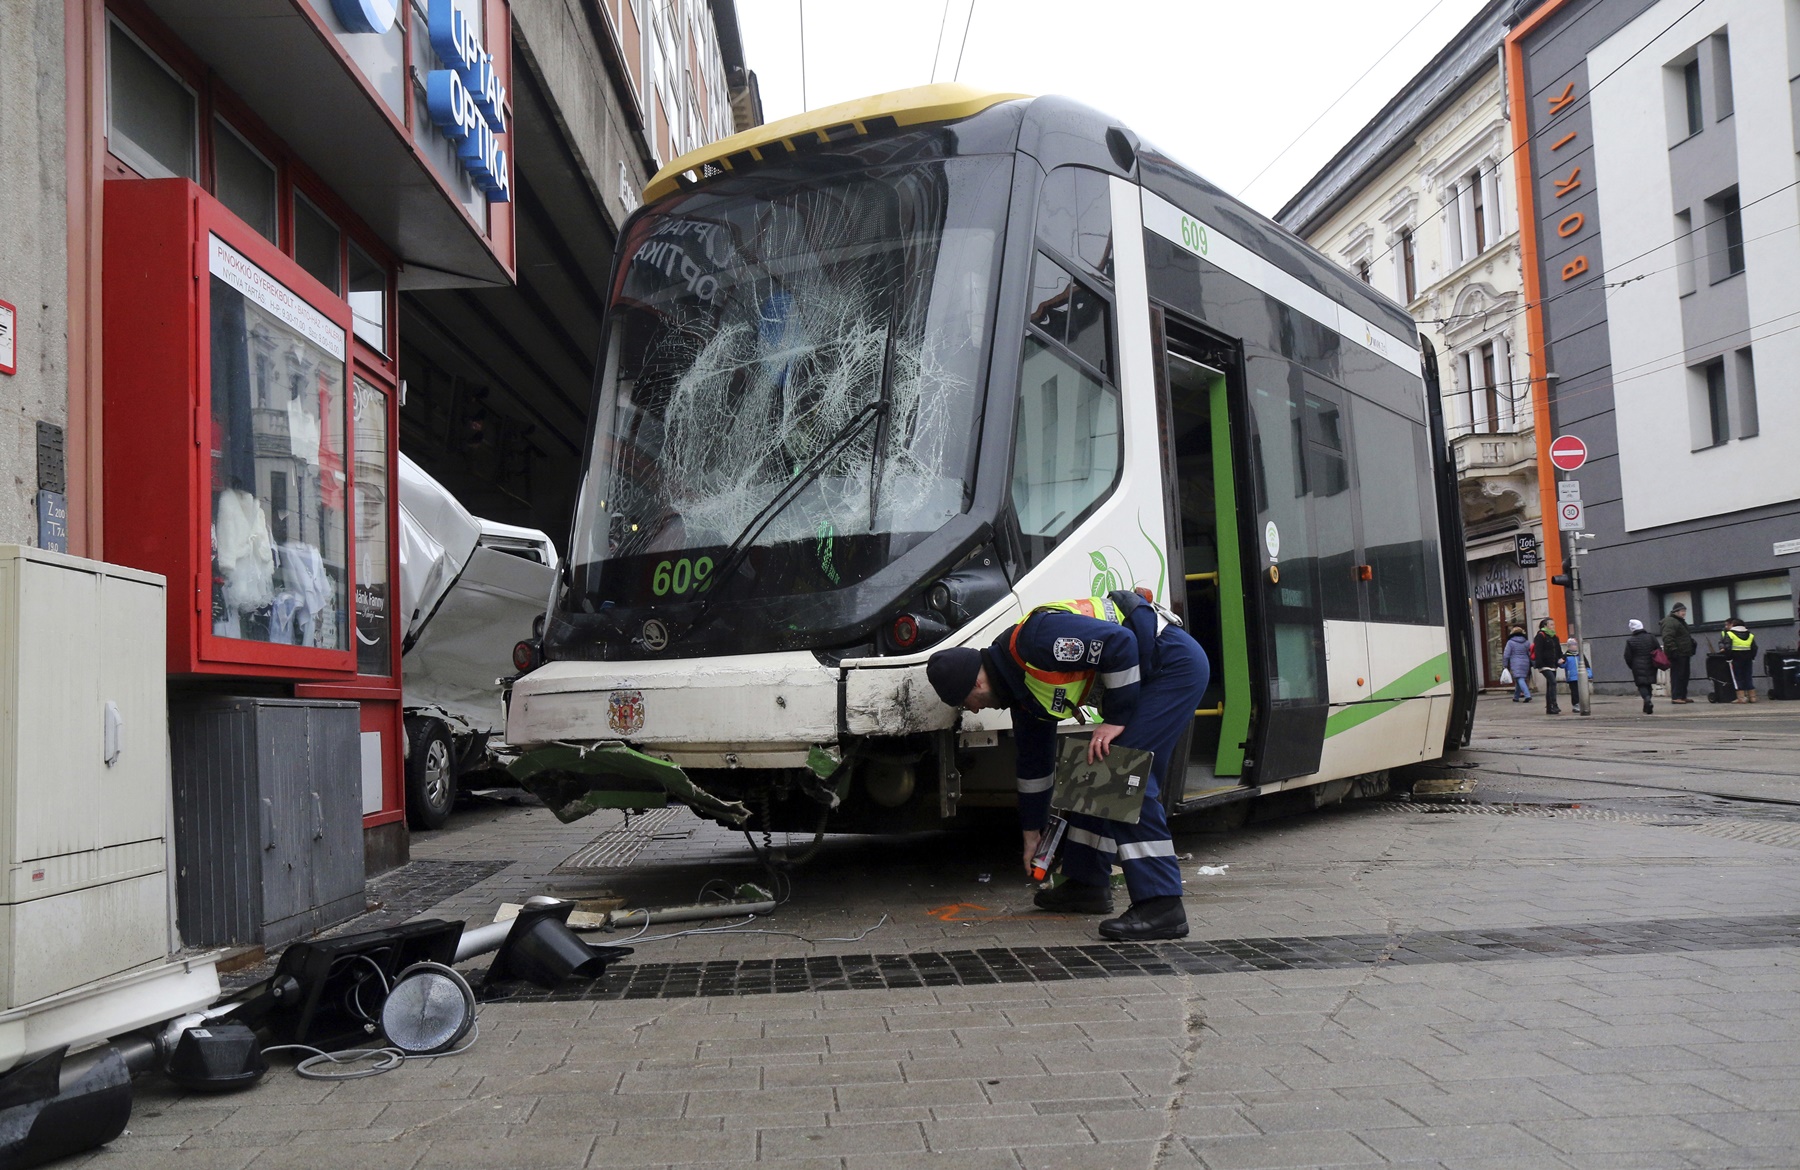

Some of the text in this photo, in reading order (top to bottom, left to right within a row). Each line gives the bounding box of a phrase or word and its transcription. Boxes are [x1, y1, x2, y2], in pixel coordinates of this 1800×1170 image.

[450, 0, 506, 133] LIPTÁK
[450, 69, 510, 202] OPTIKA
[1549, 82, 1589, 281] BOKIK
[1181, 215, 1207, 256] 609
[217, 246, 252, 280] PINOKKIÓ
[253, 272, 294, 308] GYEREKBOLT
[222, 267, 244, 289] NYITVA
[55, 508, 65, 519] 200
[1566, 508, 1576, 516] 30
[1519, 538, 1535, 548] Toti
[653, 556, 714, 596] 609
[369, 592, 384, 611] Fanny
